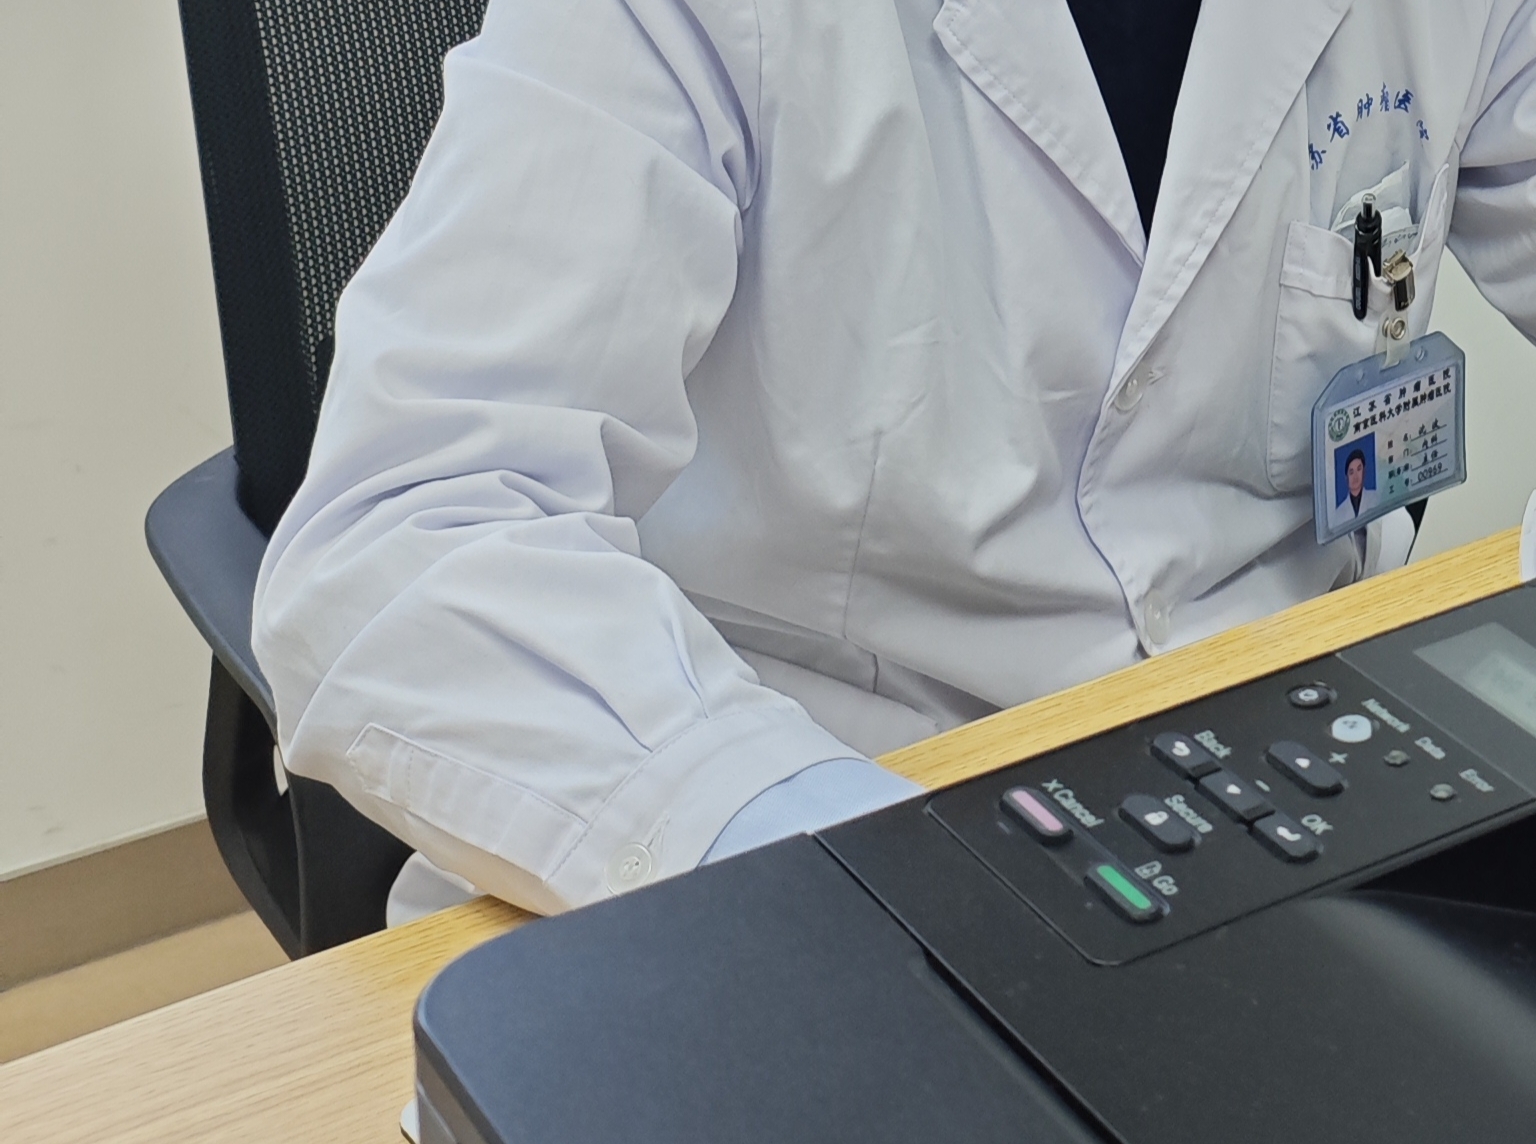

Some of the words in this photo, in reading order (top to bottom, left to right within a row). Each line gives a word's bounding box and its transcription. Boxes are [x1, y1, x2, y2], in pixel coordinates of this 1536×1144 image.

[1361, 698, 1411, 733] Network
[1194, 730, 1232, 759] Back
[1414, 737, 1446, 760] Data
[1459, 768, 1494, 792] Error
[1053, 789, 1104, 828] Cancel
[1164, 794, 1213, 833] Secure
[1301, 813, 1333, 836] OK
[1152, 875, 1179, 896] Go
